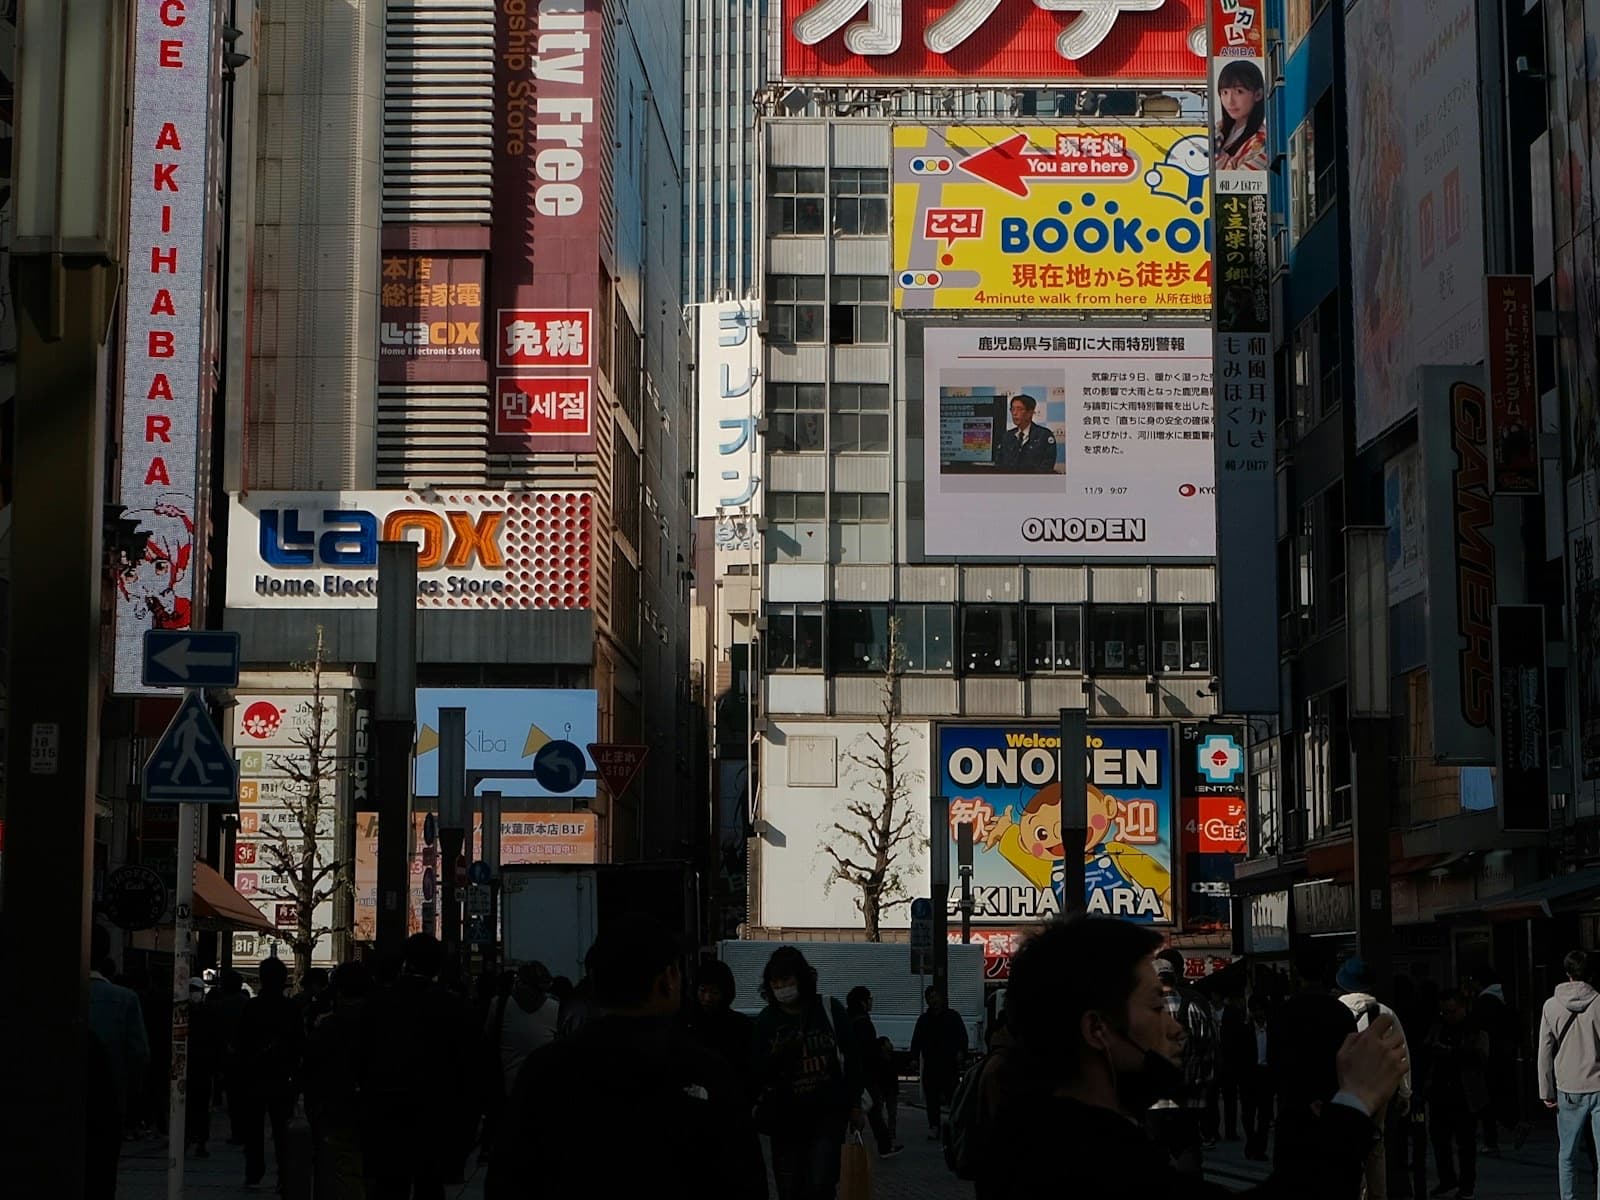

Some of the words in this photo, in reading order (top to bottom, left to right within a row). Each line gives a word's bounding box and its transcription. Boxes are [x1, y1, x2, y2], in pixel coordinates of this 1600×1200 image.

[1221, 47, 1256, 56] AKIBA
[506, 78, 531, 157] Store
[1058, 135, 1125, 158] 現在地
[534, 97, 594, 218] Free
[1027, 158, 1057, 174] You
[1060, 161, 1087, 174] are
[1092, 158, 1129, 174] here
[382, 255, 432, 280] 本店
[145, 122, 182, 486] AKIHABARA
[1040, 293, 1072, 304] walk
[1076, 293, 1109, 304] from
[1114, 293, 1147, 304] here
[504, 318, 584, 359] 免税
[978, 336, 1186, 352] 鹿児島県与論町に大雨特別警報
[381, 347, 406, 356] Home
[408, 347, 456, 356] Electronics
[458, 347, 481, 356] Store
[502, 390, 586, 423] 면세점
[1085, 486, 1103, 496] 11/9
[1110, 486, 1128, 496] 9:07
[1022, 517, 1146, 542] ONODEN
[1449, 380, 1498, 738] GAMERS
[254, 575, 314, 594] Home
[323, 575, 438, 594] Electcs
[447, 575, 504, 594] Store
[601, 751, 636, 763] 止まれ
[605, 765, 633, 777] STOP
[949, 748, 1159, 786] ONOEN
[240, 784, 255, 797] 5F
[238, 846, 252, 860] 3F
[240, 879, 255, 891] 2F
